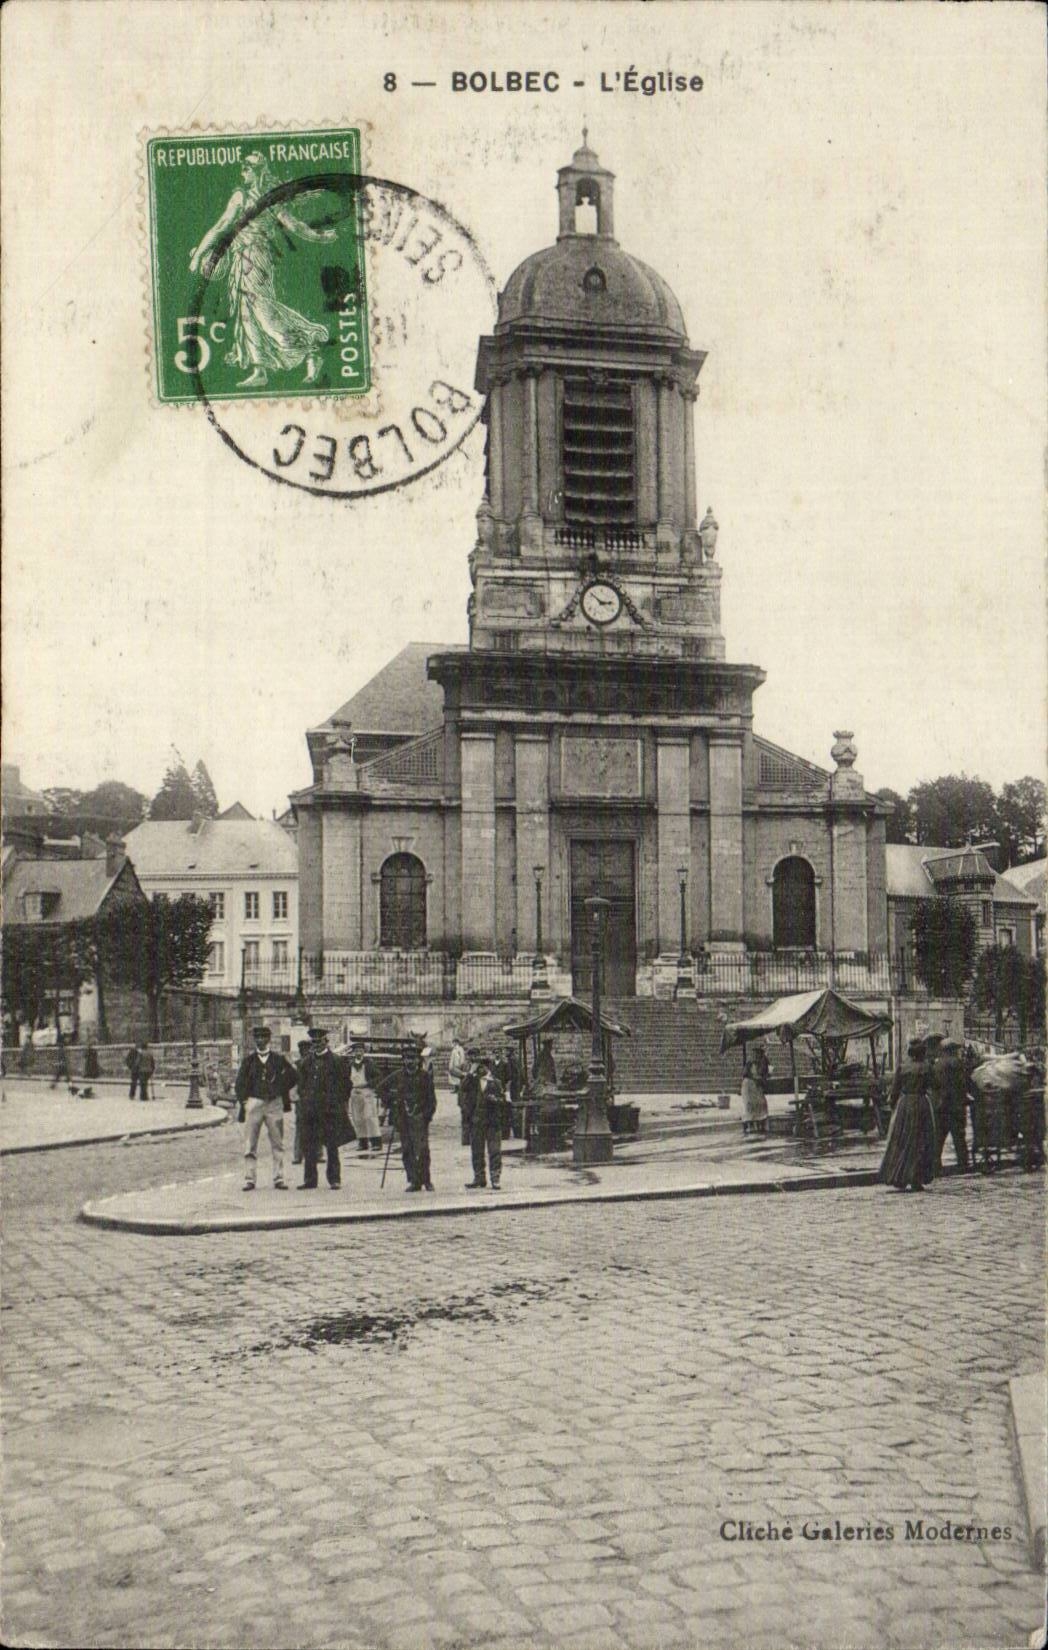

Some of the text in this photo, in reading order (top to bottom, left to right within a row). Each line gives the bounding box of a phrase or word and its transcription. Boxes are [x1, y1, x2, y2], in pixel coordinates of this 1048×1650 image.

[156, 141, 350, 168] REPUBLIQUE FRANÇAISE
[339, 291, 360, 378] POSTES
[273, 380, 472, 481] BOLBEC
